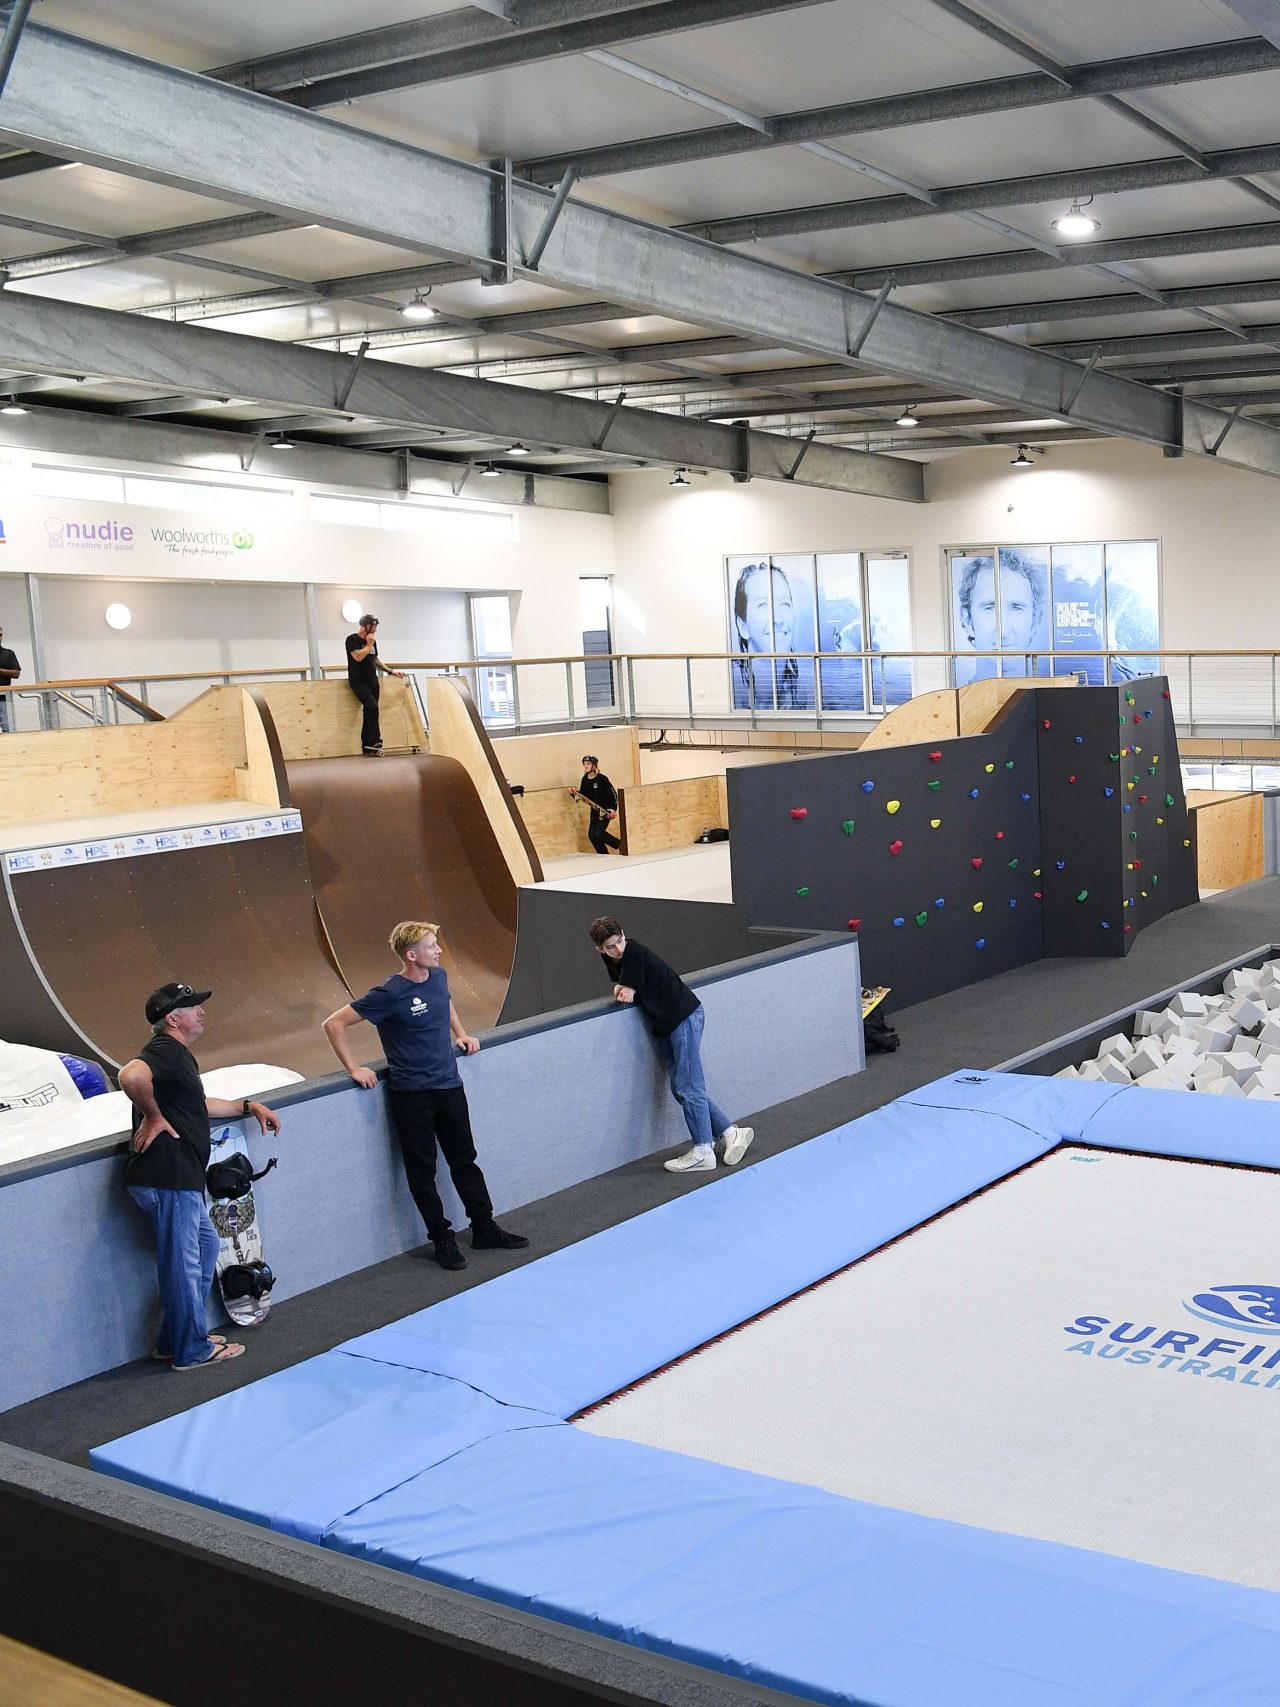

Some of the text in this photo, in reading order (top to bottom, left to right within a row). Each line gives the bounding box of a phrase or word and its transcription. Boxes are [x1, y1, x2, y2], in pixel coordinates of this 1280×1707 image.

[66, 521, 134, 541] nudie
[150, 528, 229, 545] Woolworths
[67, 542, 102, 550] creators
[164, 543, 180, 553] The
[182, 545, 199, 557] fresh
[200, 546, 215, 558] food
[9, 856, 34, 868] HPC
[85, 846, 108, 857] HPC
[155, 836, 177, 847] HPC
[220, 828, 241, 838] HPC
[281, 819, 301, 829] HPC
